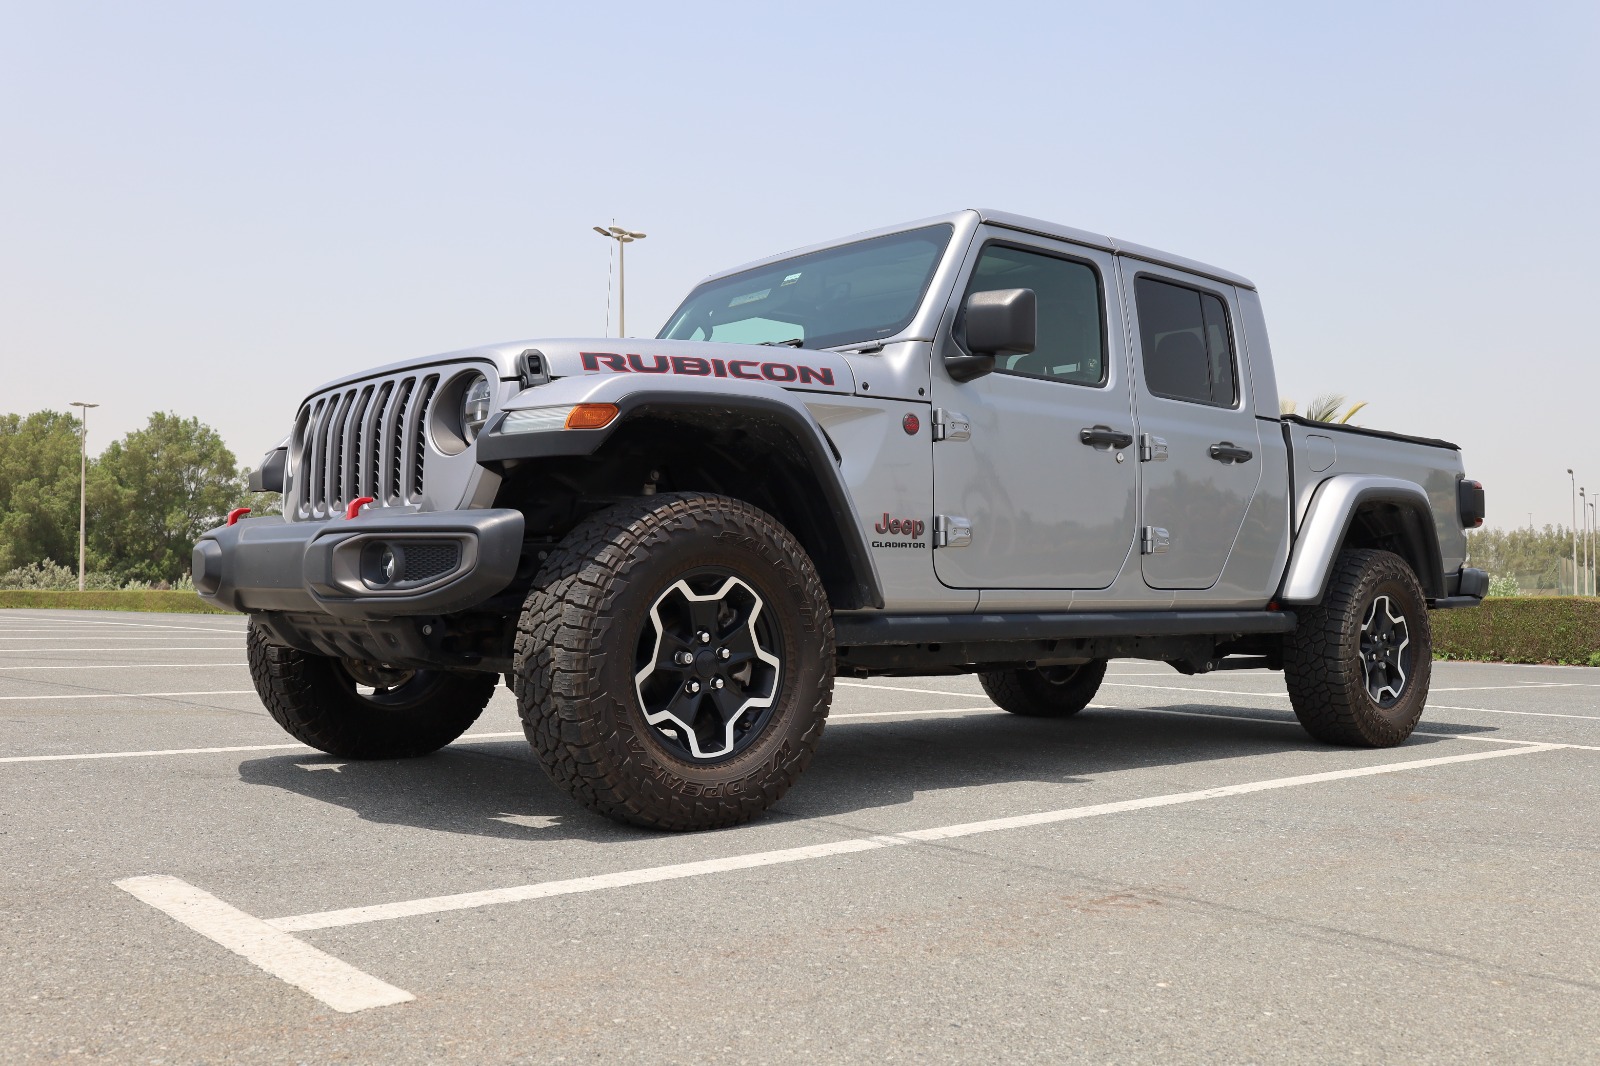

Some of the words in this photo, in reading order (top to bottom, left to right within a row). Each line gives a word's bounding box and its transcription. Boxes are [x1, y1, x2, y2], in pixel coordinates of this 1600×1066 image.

[579, 351, 835, 386] RUBICON
[875, 512, 925, 540] Jeep
[872, 541, 926, 549] GLADIATOR
[640, 739, 793, 799] WILDPEAK
